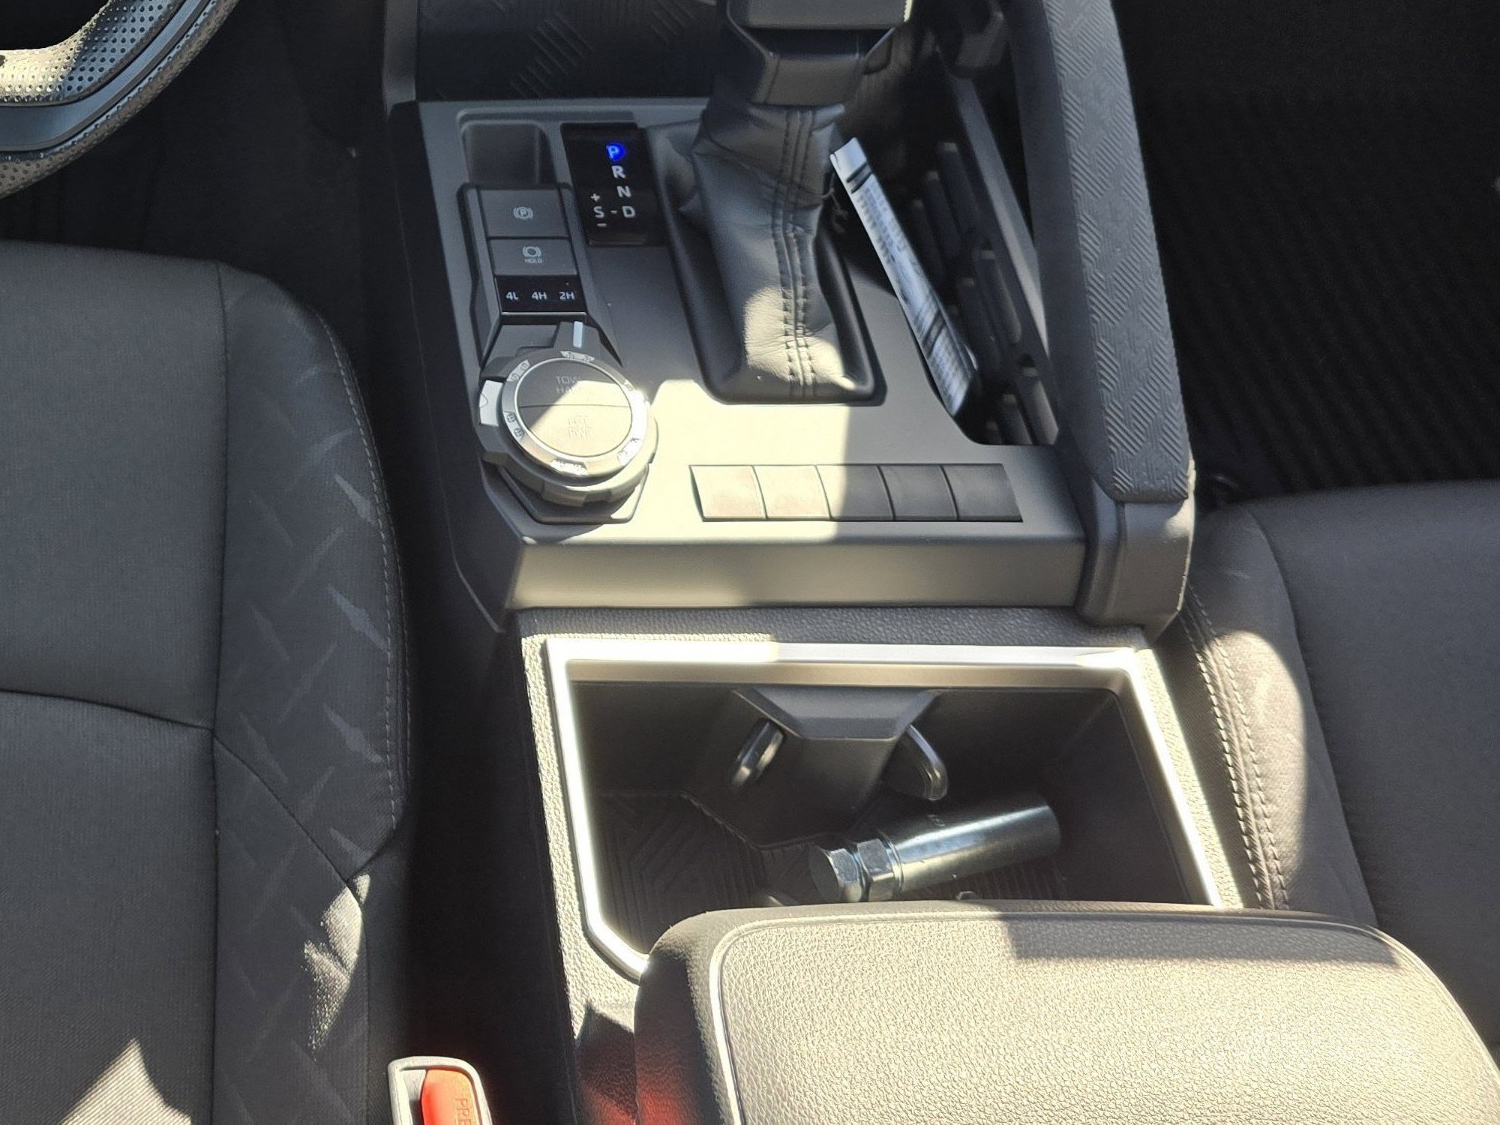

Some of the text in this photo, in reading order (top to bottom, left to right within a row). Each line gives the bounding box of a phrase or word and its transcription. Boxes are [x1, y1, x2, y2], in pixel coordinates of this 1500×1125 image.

[606, 144, 620, 159] P
[611, 165, 626, 179] R
[616, 185, 632, 198] N
[593, 205, 636, 218] S D
[506, 291, 576, 301] 4L 4H 2H
[556, 375, 581, 385] TOW
